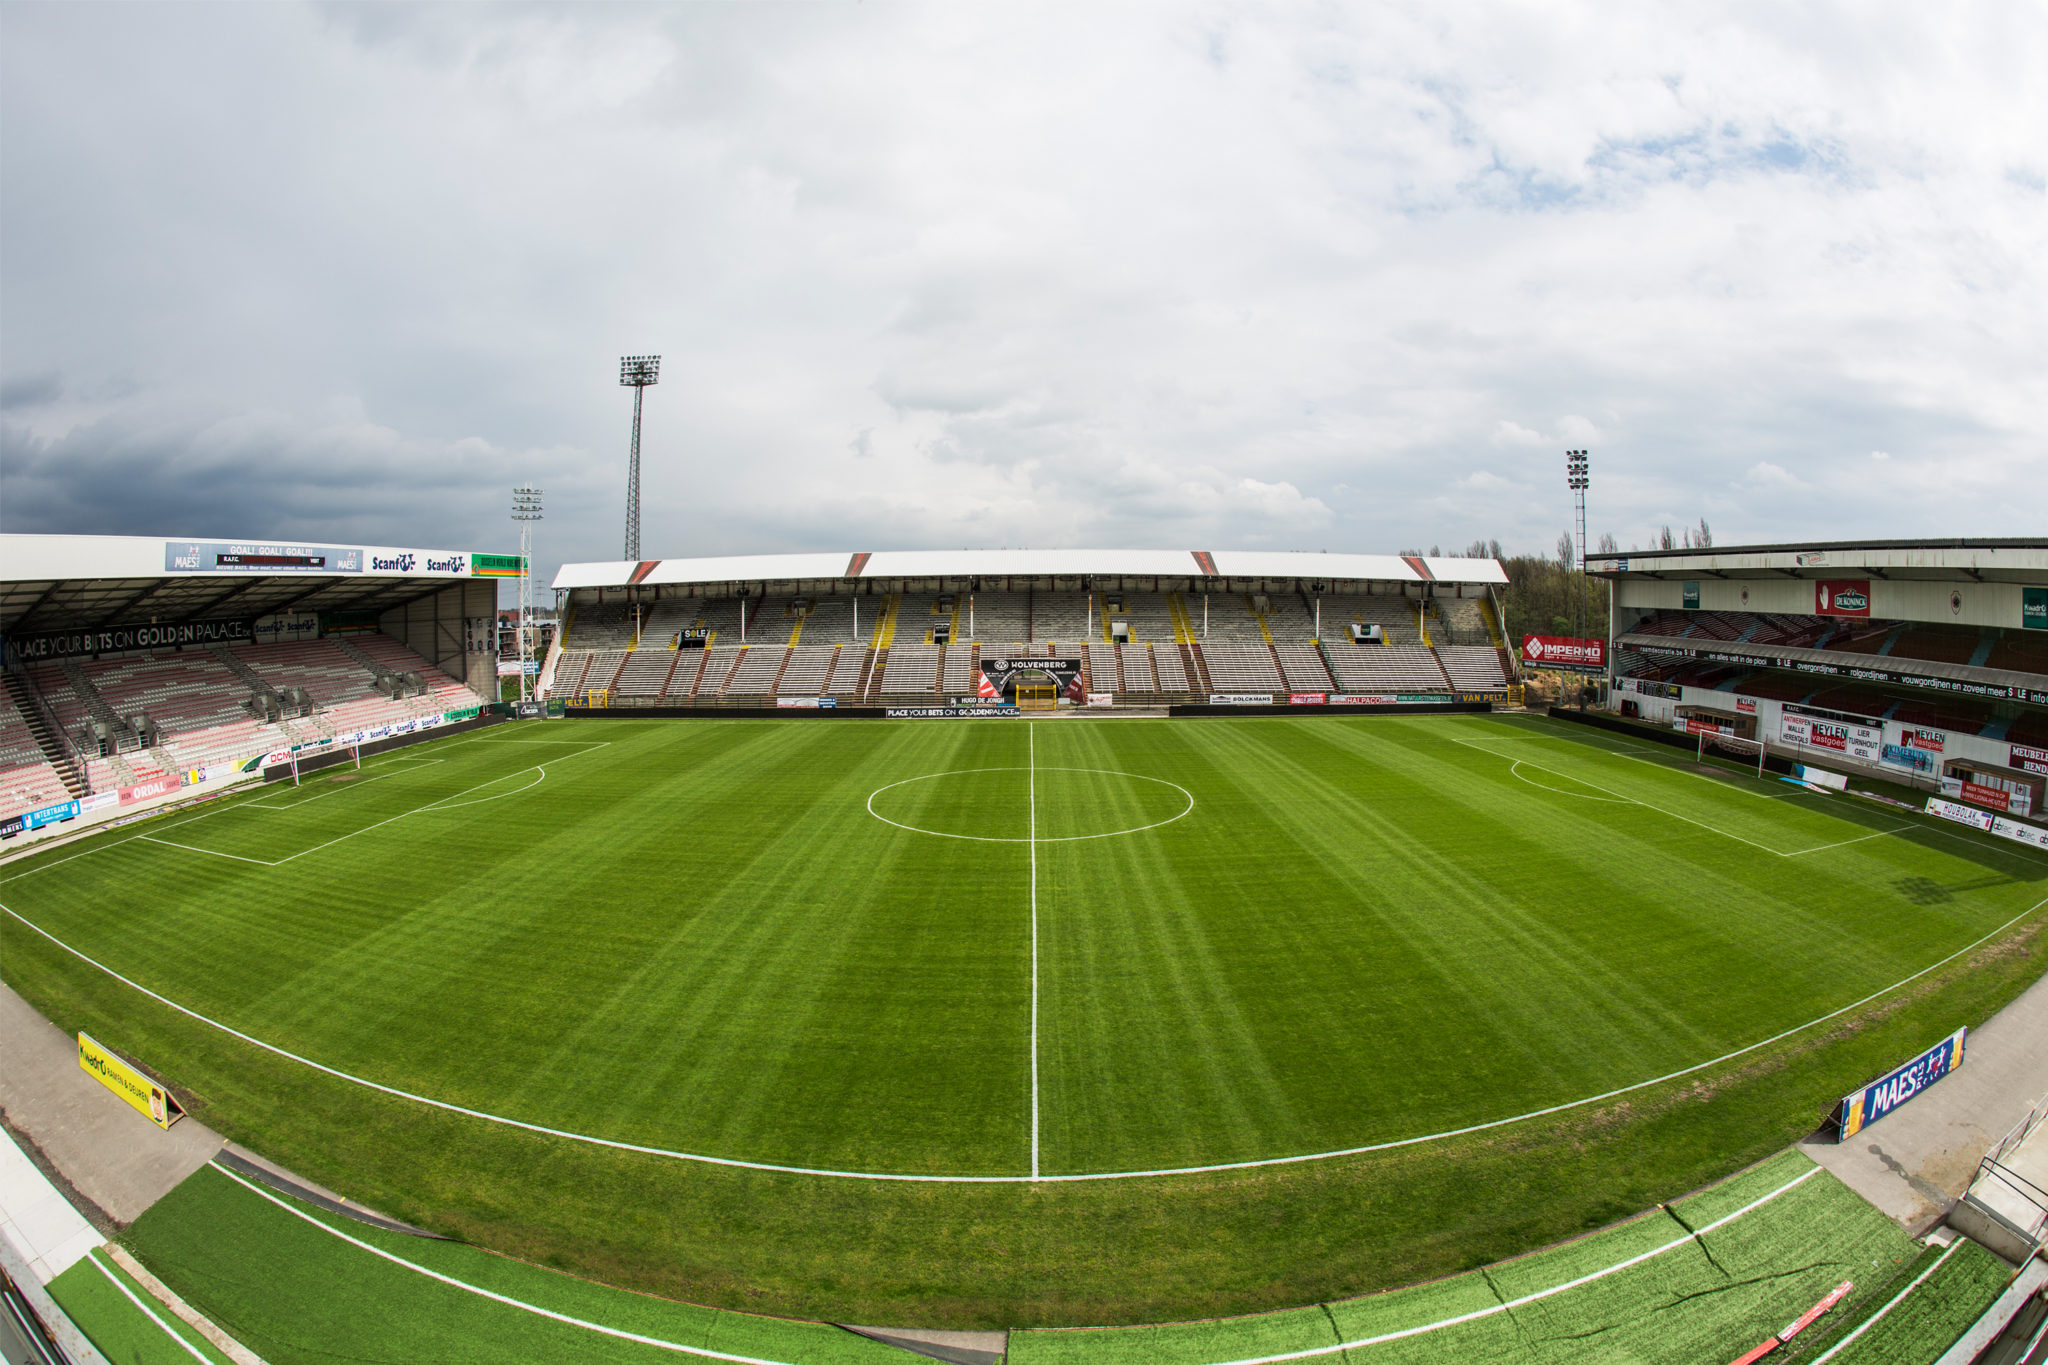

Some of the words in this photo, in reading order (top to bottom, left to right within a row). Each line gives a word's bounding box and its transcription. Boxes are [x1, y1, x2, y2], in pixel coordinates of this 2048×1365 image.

[174, 556, 197, 568] MAES
[337, 560, 354, 570] MAES
[1836, 596, 1843, 605] DE
[1844, 597, 1866, 607] KONINCK
[49, 636, 82, 654] YOUR
[114, 631, 134, 648] ON
[1544, 644, 1600, 656] IMPERMO
[1717, 653, 1729, 661] alles
[1740, 655, 1745, 663] in
[1746, 656, 1753, 664] de
[1011, 661, 1067, 669] WOLVENBERG
[1797, 663, 1838, 674] overgordijnen
[1850, 669, 1888, 680] rolgordijnen
[1902, 676, 1950, 689] vouwgordijnen
[1952, 682, 1961, 690] en
[1962, 683, 1986, 694] zoveel
[1988, 688, 2006, 697] meer
[1463, 694, 1480, 702] VAN
[1784, 715, 1811, 726] ANTWERPEN
[1788, 725, 1804, 734] MALLE
[1812, 723, 1848, 739] HEYLEN
[1857, 729, 1870, 738] LIER
[1915, 728, 1945, 743] HEYLEN
[1783, 733, 1808, 744] HERENTALS
[1812, 735, 1846, 747] vastgoed
[1848, 737, 1878, 749] TURNHOUT
[1915, 739, 1944, 749] vastgoed
[271, 751, 291, 763] DCM
[1854, 748, 1869, 757] GEEL
[2024, 761, 2048, 773] HEND
[133, 782, 166, 799] ORDAL
[34, 804, 69, 819] INTERTRANS
[1944, 803, 1977, 820] HOUBOLAK
[107, 1068, 123, 1085] RAMEN
[124, 1079, 128, 1088] &
[129, 1082, 149, 1104] DEUREN
[1870, 1066, 1918, 1120] MAES
